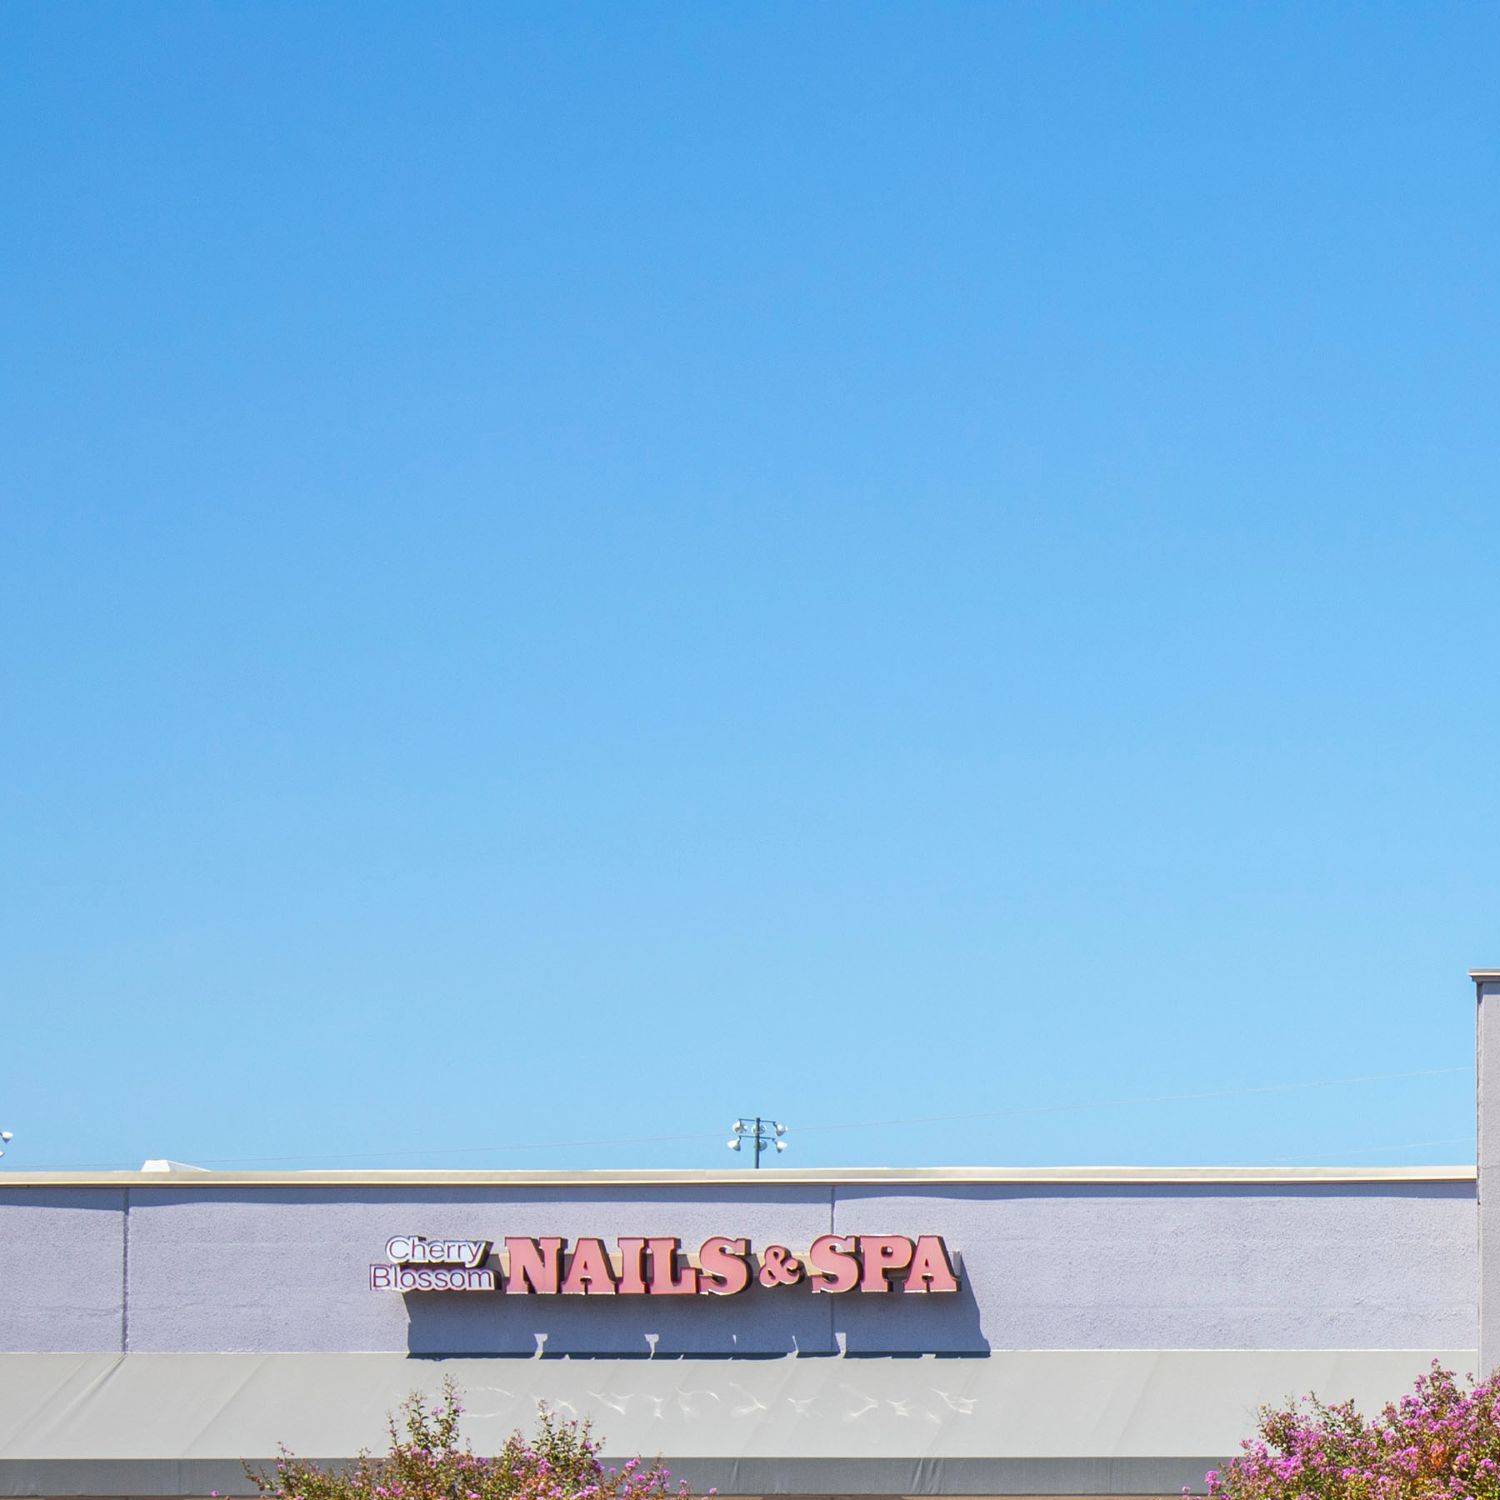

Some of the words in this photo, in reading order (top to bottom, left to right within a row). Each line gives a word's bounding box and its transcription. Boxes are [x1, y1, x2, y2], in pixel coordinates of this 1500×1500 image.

[386, 1236, 484, 1268] Cherry
[504, 1236, 751, 1296] NAILS
[809, 1235, 959, 1295] SPA
[369, 1264, 496, 1292] Blossom
